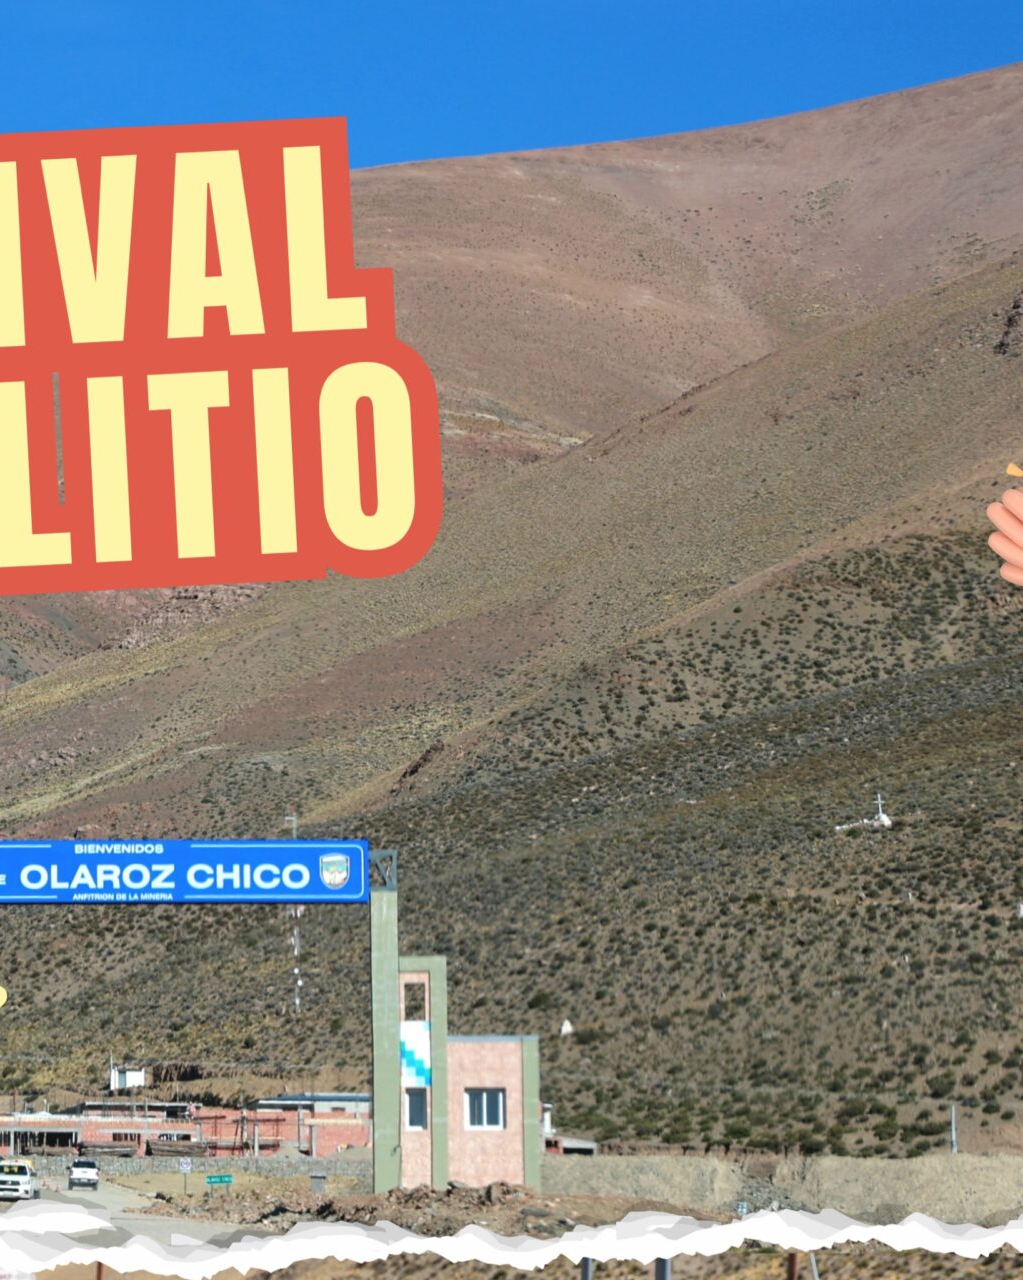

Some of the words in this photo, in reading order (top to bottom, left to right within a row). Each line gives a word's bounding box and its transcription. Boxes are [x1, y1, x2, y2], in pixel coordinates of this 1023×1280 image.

[74, 843, 164, 854] BIENVENIDOS
[20, 863, 176, 889] OLAROZ
[187, 863, 310, 889] CHICO
[73, 893, 115, 901] ANFITRION
[115, 893, 127, 901] DE
[128, 893, 139, 901] LA
[140, 893, 173, 901] MINERIA
